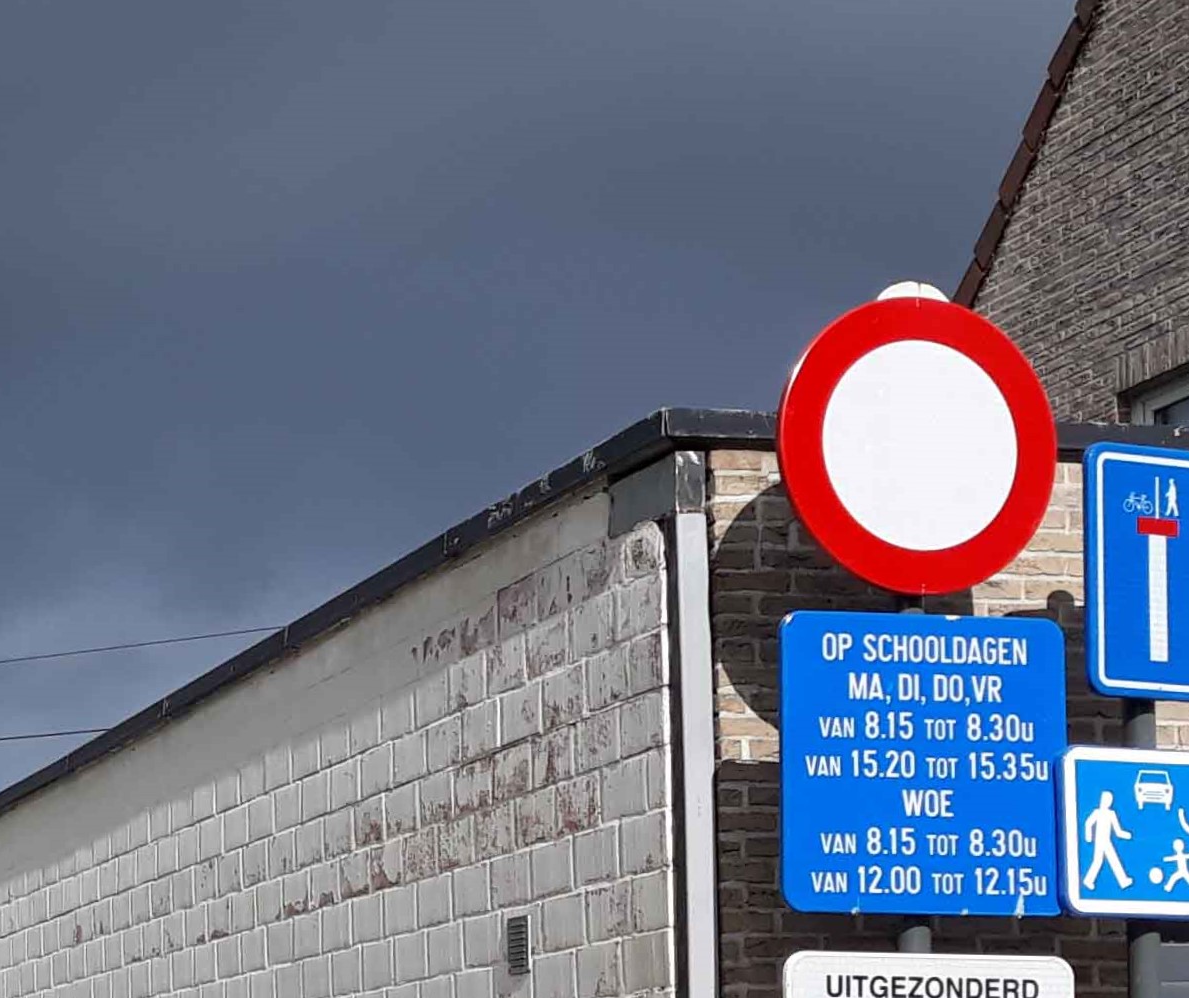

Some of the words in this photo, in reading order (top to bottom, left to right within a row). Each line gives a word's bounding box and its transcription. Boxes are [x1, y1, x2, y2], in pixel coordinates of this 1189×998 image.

[823, 633, 852, 660] OP
[864, 634, 1027, 665] SCHOOLDAGEN
[849, 673, 890, 703] MA,
[899, 674, 925, 704] DI,
[820, 717, 854, 737] VAN
[866, 711, 913, 739] 8.15
[925, 719, 956, 740] TOT
[968, 714, 1033, 741] 8.30u
[806, 756, 840, 776] VAN
[852, 750, 915, 778] 15.20
[926, 758, 957, 778] TOT
[969, 752, 1048, 780] 15.35u
[903, 790, 954, 817] WOE
[821, 834, 856, 853] VAN
[867, 827, 915, 855] 8.15
[927, 835, 958, 855] TOT
[970, 829, 1036, 857] 8.30u
[812, 872, 847, 892] VAN
[858, 866, 920, 894] 12.00
[932, 874, 963, 894] TOT
[975, 868, 1046, 896] 12.15u
